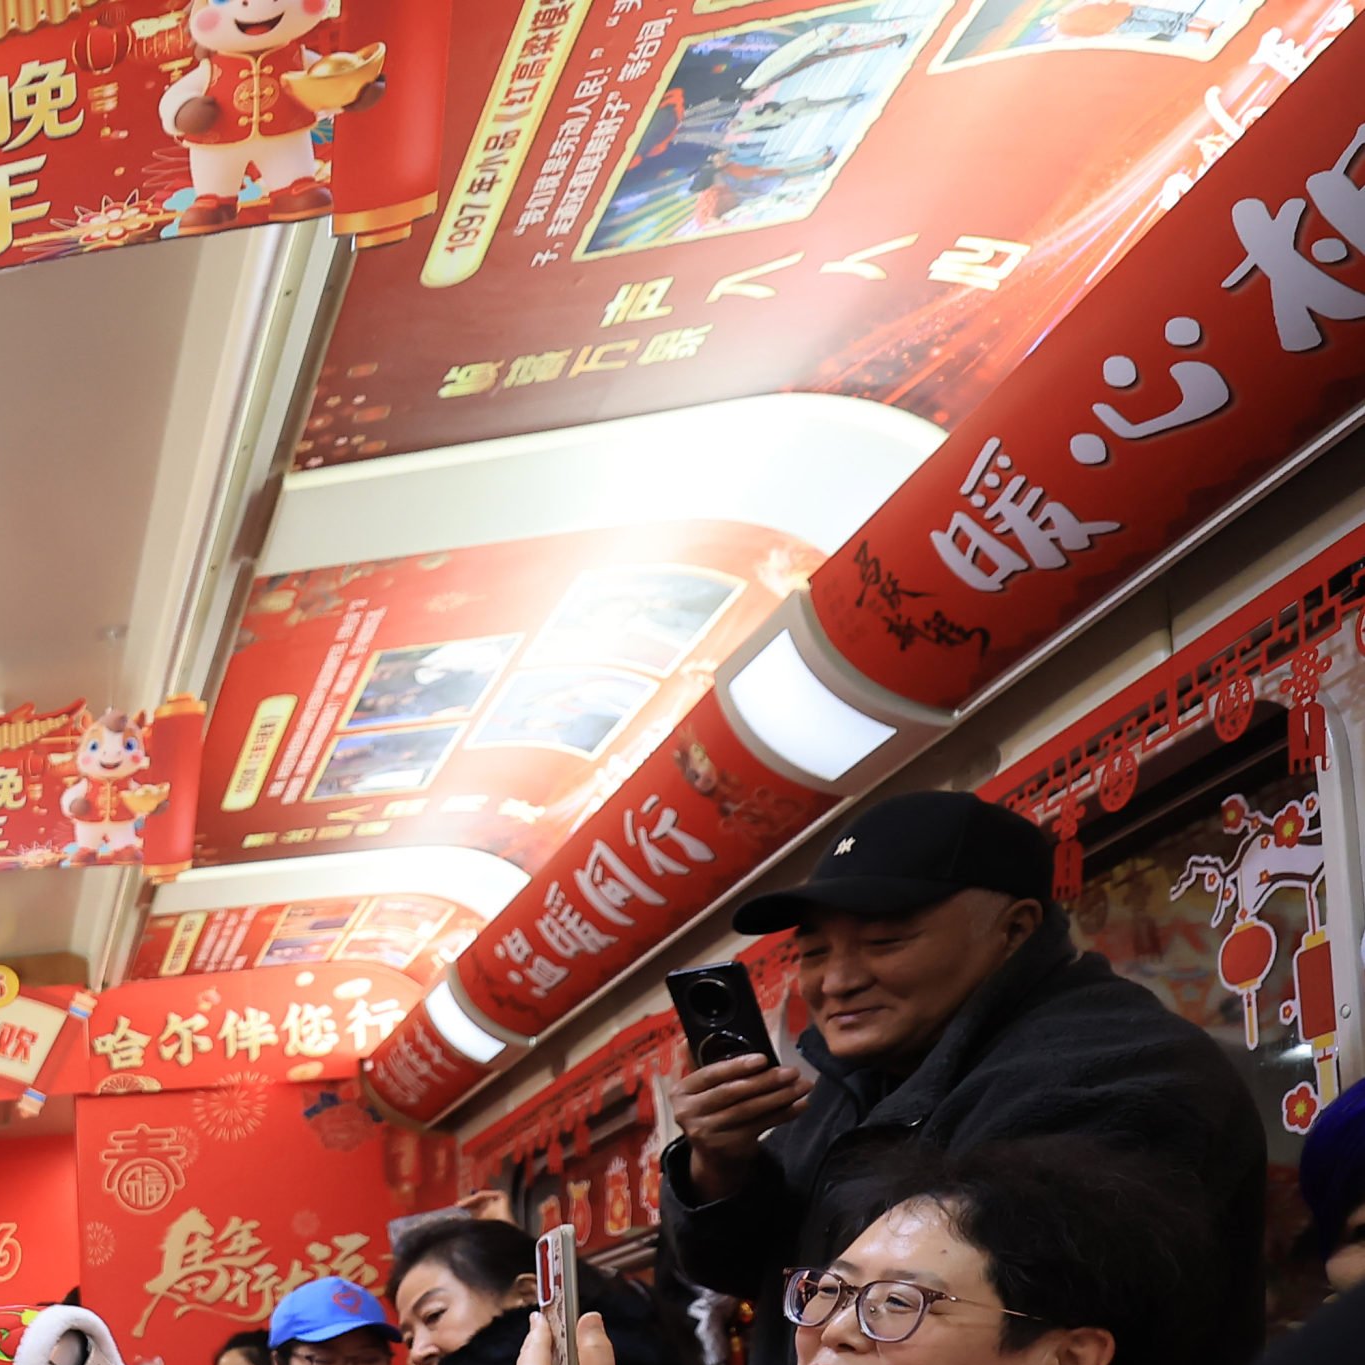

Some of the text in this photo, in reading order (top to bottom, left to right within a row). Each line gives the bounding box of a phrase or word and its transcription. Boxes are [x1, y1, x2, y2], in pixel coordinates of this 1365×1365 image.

[444, 0, 574, 253] 1997 年小品《红高粱模
[600, 233, 1032, 327] 声入人心
[93, 999, 408, 1070] 哈尔伴您行
